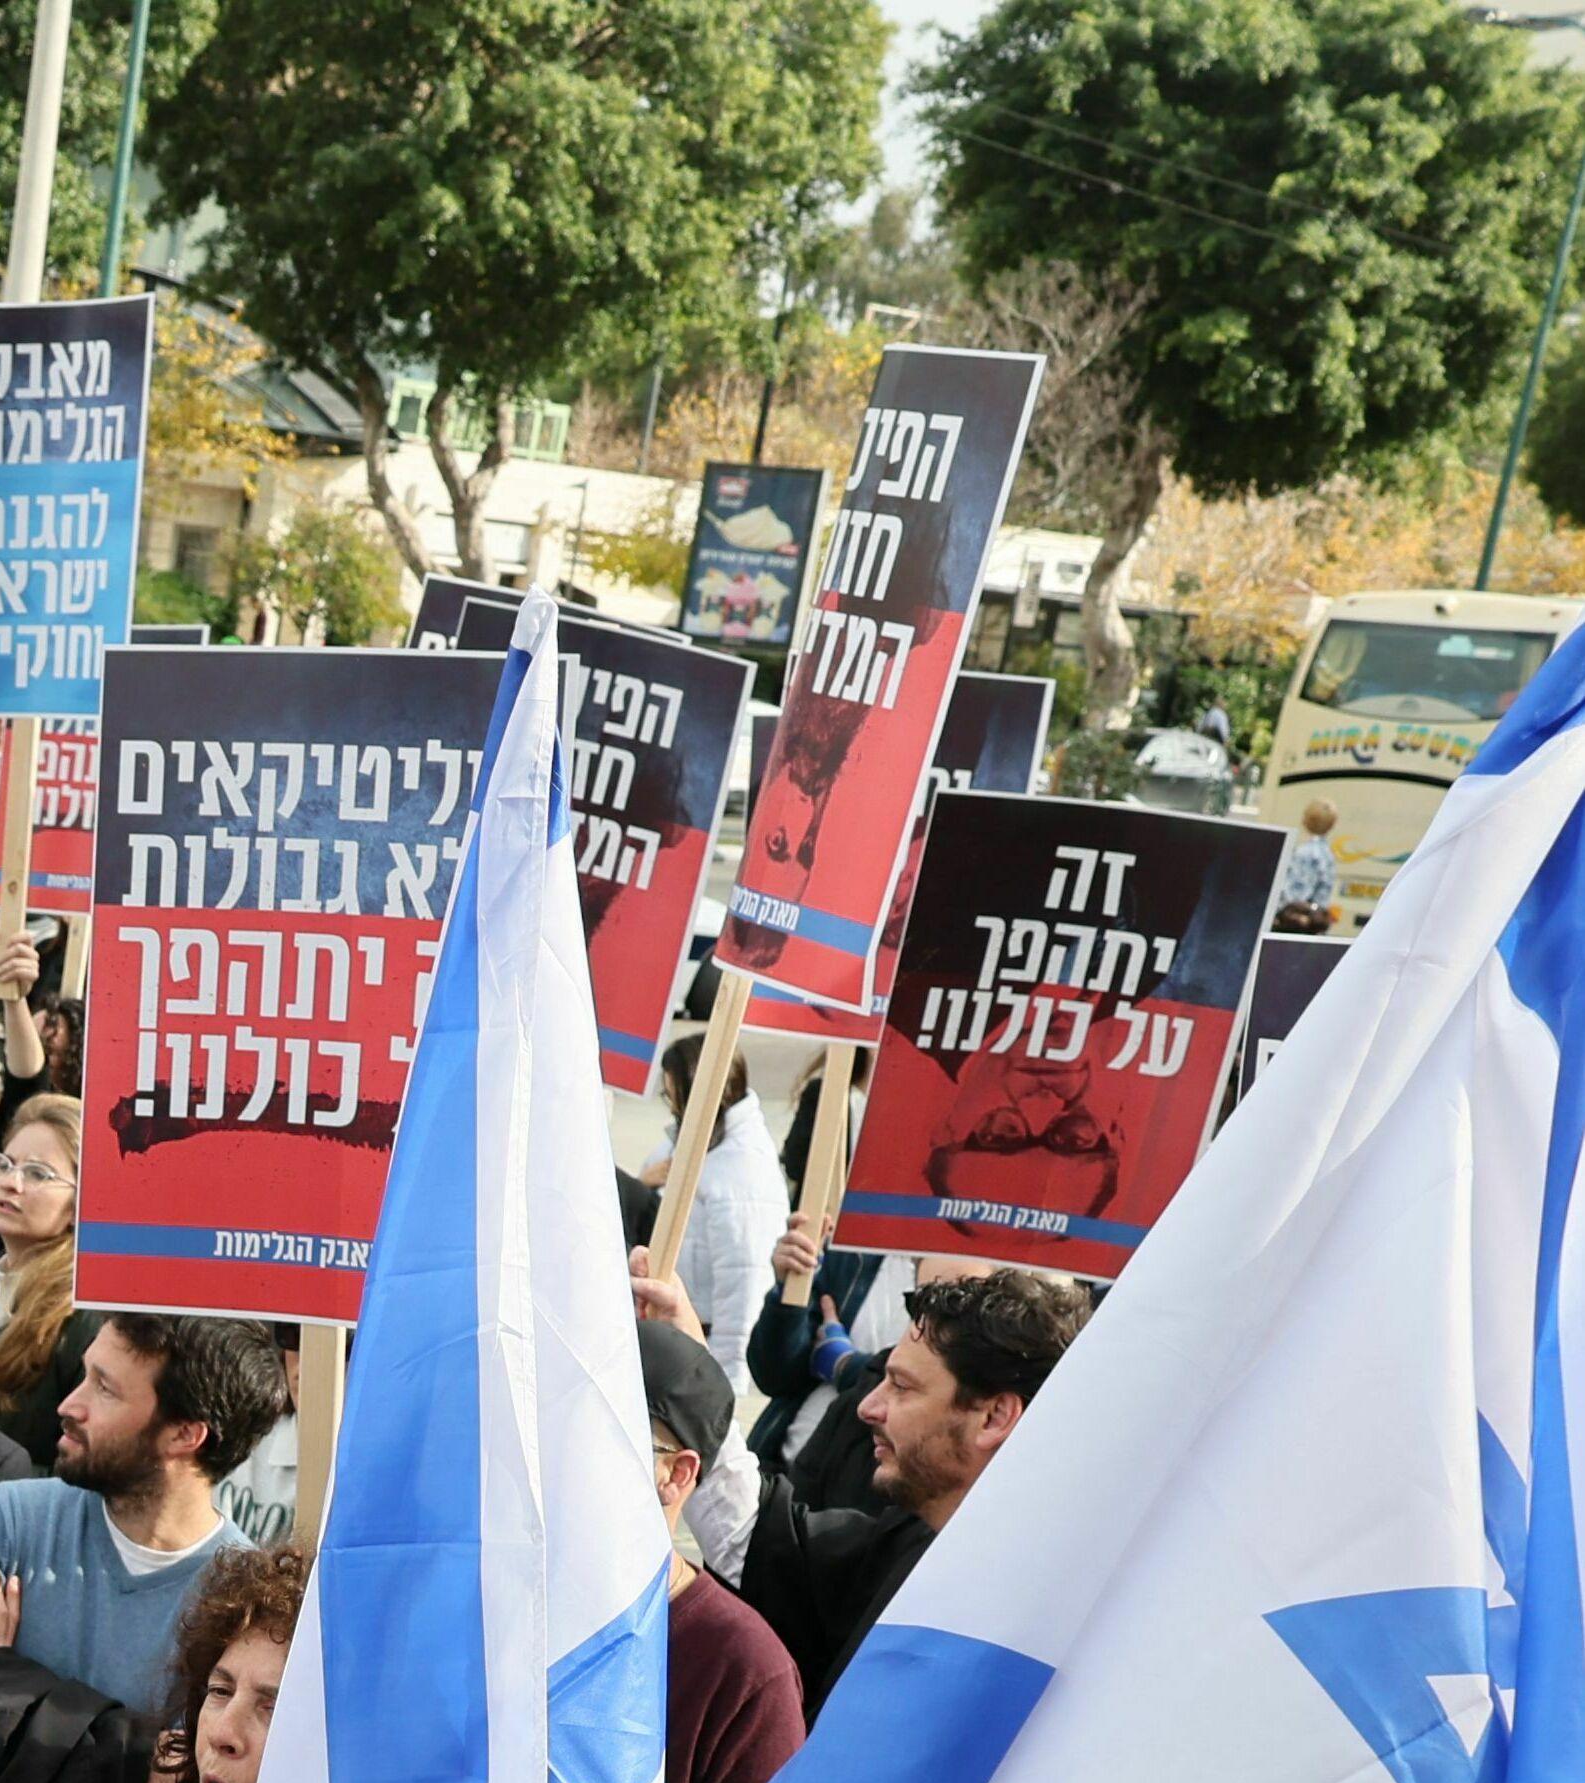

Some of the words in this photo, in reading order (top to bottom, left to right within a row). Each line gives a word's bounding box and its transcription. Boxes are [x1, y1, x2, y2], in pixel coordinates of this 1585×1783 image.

[845, 407, 964, 503] הפיכ
[823, 509, 903, 602] חזו
[805, 609, 916, 710] המדי
[117, 739, 484, 832] וליטיקאים
[122, 827, 362, 916] גבולות
[1044, 845, 1137, 917] זה
[118, 926, 386, 1029] יתהפך
[974, 914, 1178, 996] יתהפך
[916, 985, 1094, 1063] כולנו!
[1107, 1000, 1195, 1078] על
[135, 1026, 362, 1128] כולנו!
[213, 1231, 313, 1263] הגלימות
[937, 1198, 1013, 1225] הגלימות
[1013, 1206, 1069, 1233] מאבק
[319, 1237, 373, 1269] אבק
